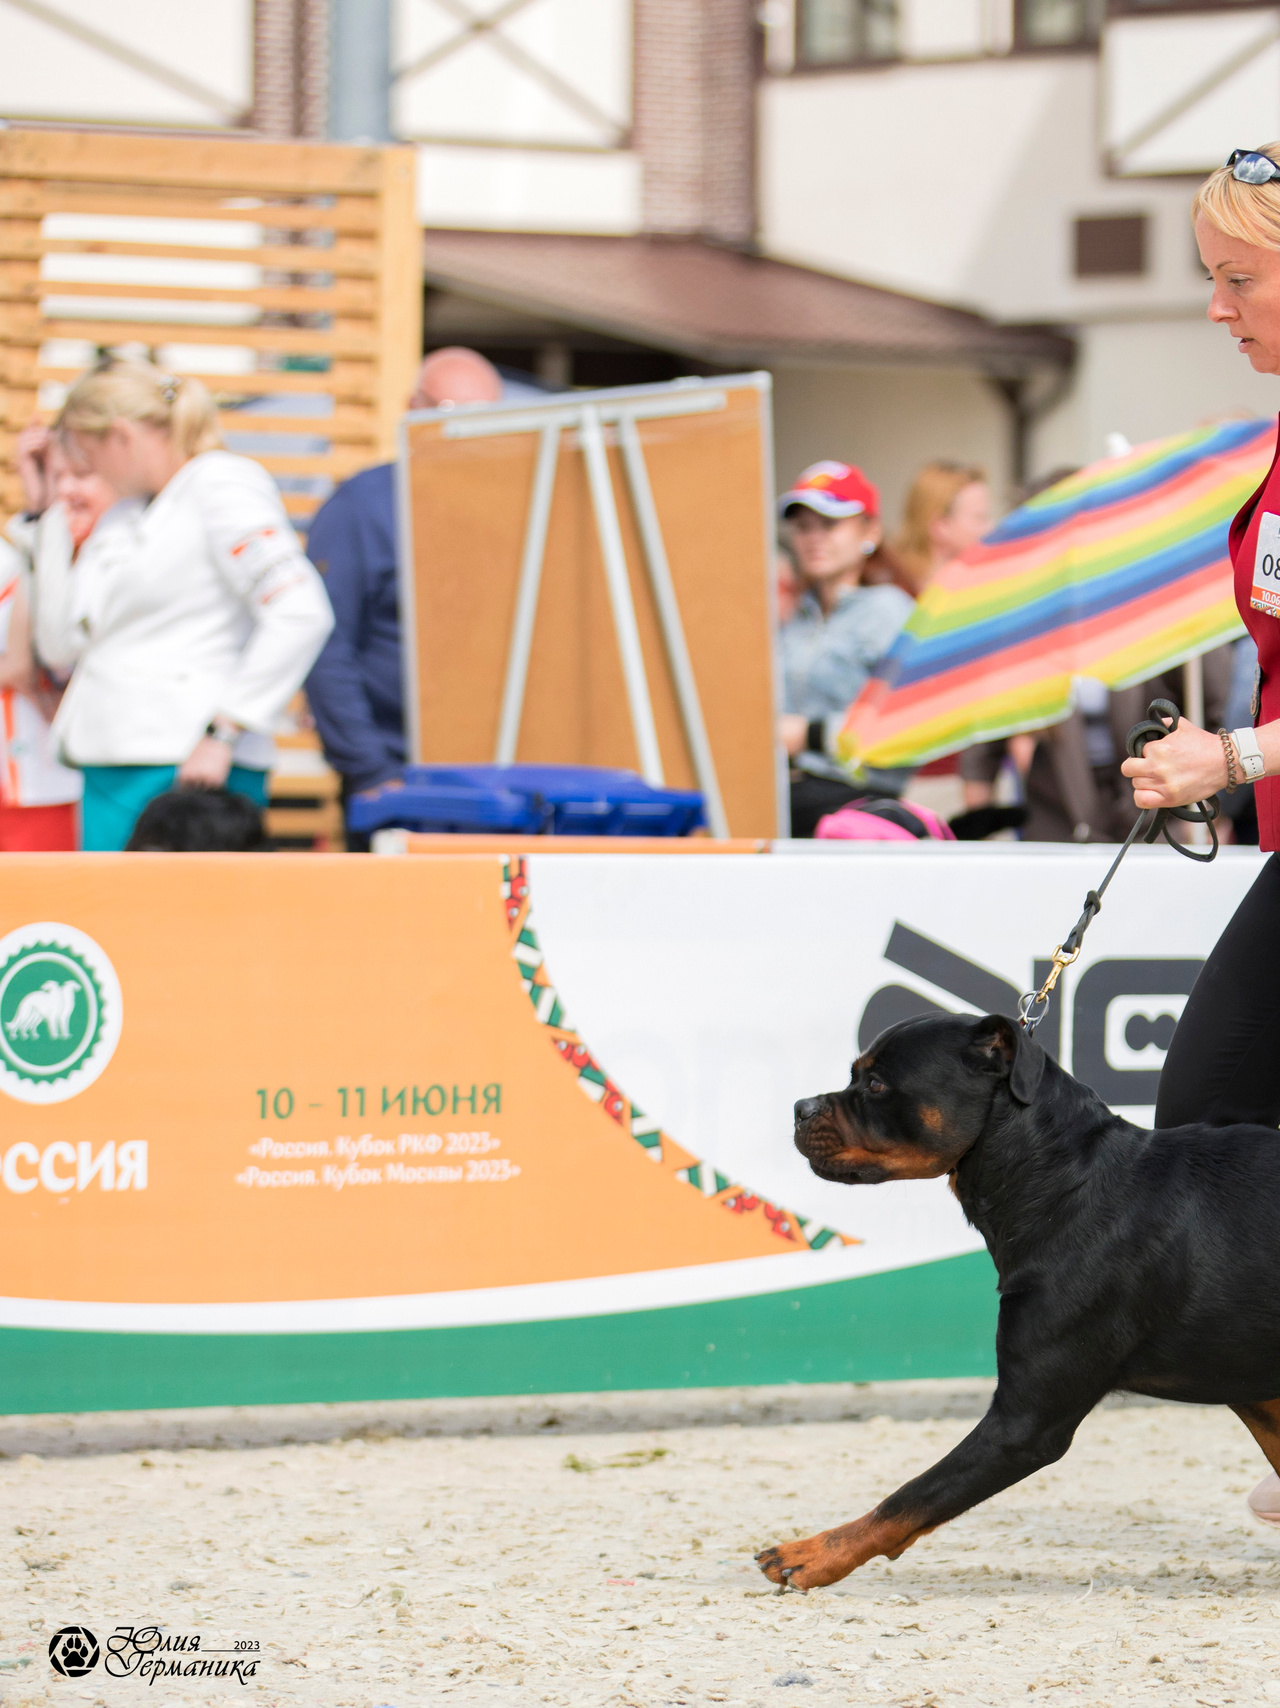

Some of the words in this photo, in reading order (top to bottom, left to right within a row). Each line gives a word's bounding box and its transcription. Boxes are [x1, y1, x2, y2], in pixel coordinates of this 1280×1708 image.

[256, 1086, 296, 1121] 10
[337, 1086, 367, 1118] 11
[381, 1083, 503, 1117] ИЮНЯ
[336, 1133, 396, 1161] Кубок
[400, 1132, 443, 1156] РКФ
[0, 1140, 149, 1194] ССИЯ
[322, 1162, 383, 1191] Кубок
[386, 1161, 463, 1185] Москвы
